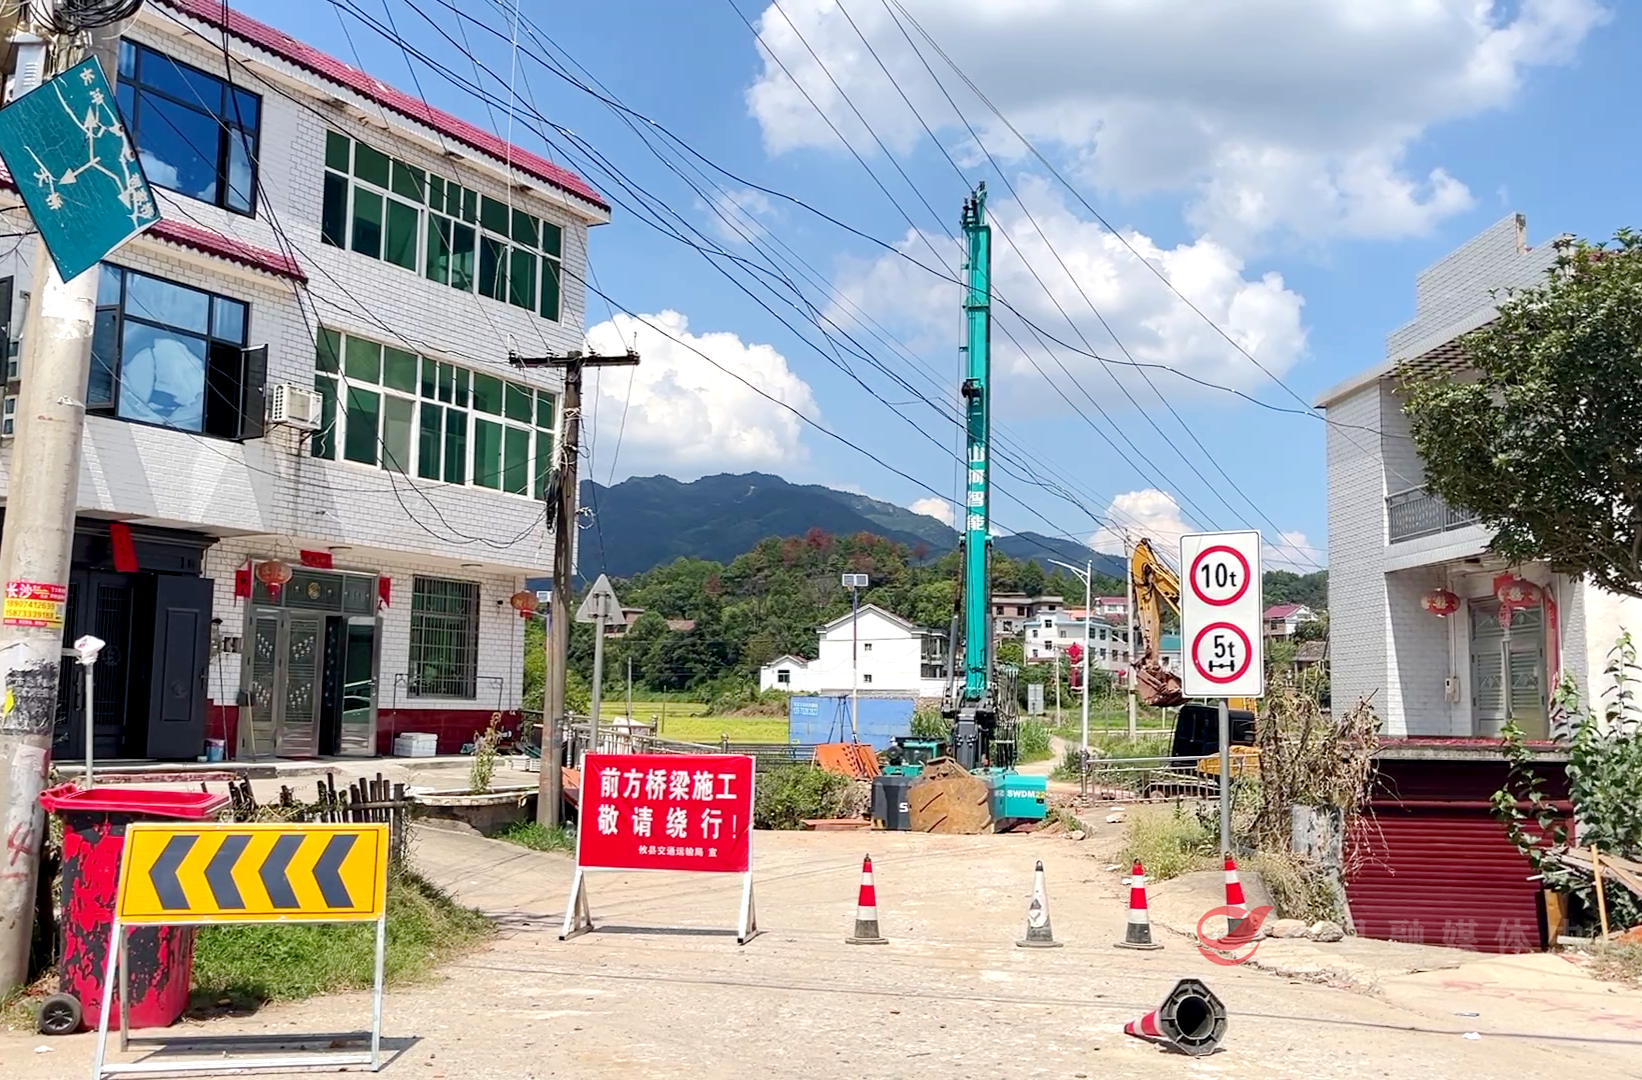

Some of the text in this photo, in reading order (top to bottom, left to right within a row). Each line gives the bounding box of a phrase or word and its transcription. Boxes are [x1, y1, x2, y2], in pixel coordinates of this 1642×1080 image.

[1201, 562, 1237, 589] 10t
[6, 582, 32, 599] 长沙
[1214, 635, 1236, 659] 5t
[600, 767, 737, 801] 前方桥梁施工
[638, 845, 718, 858] 攸县交通运输局 宣
